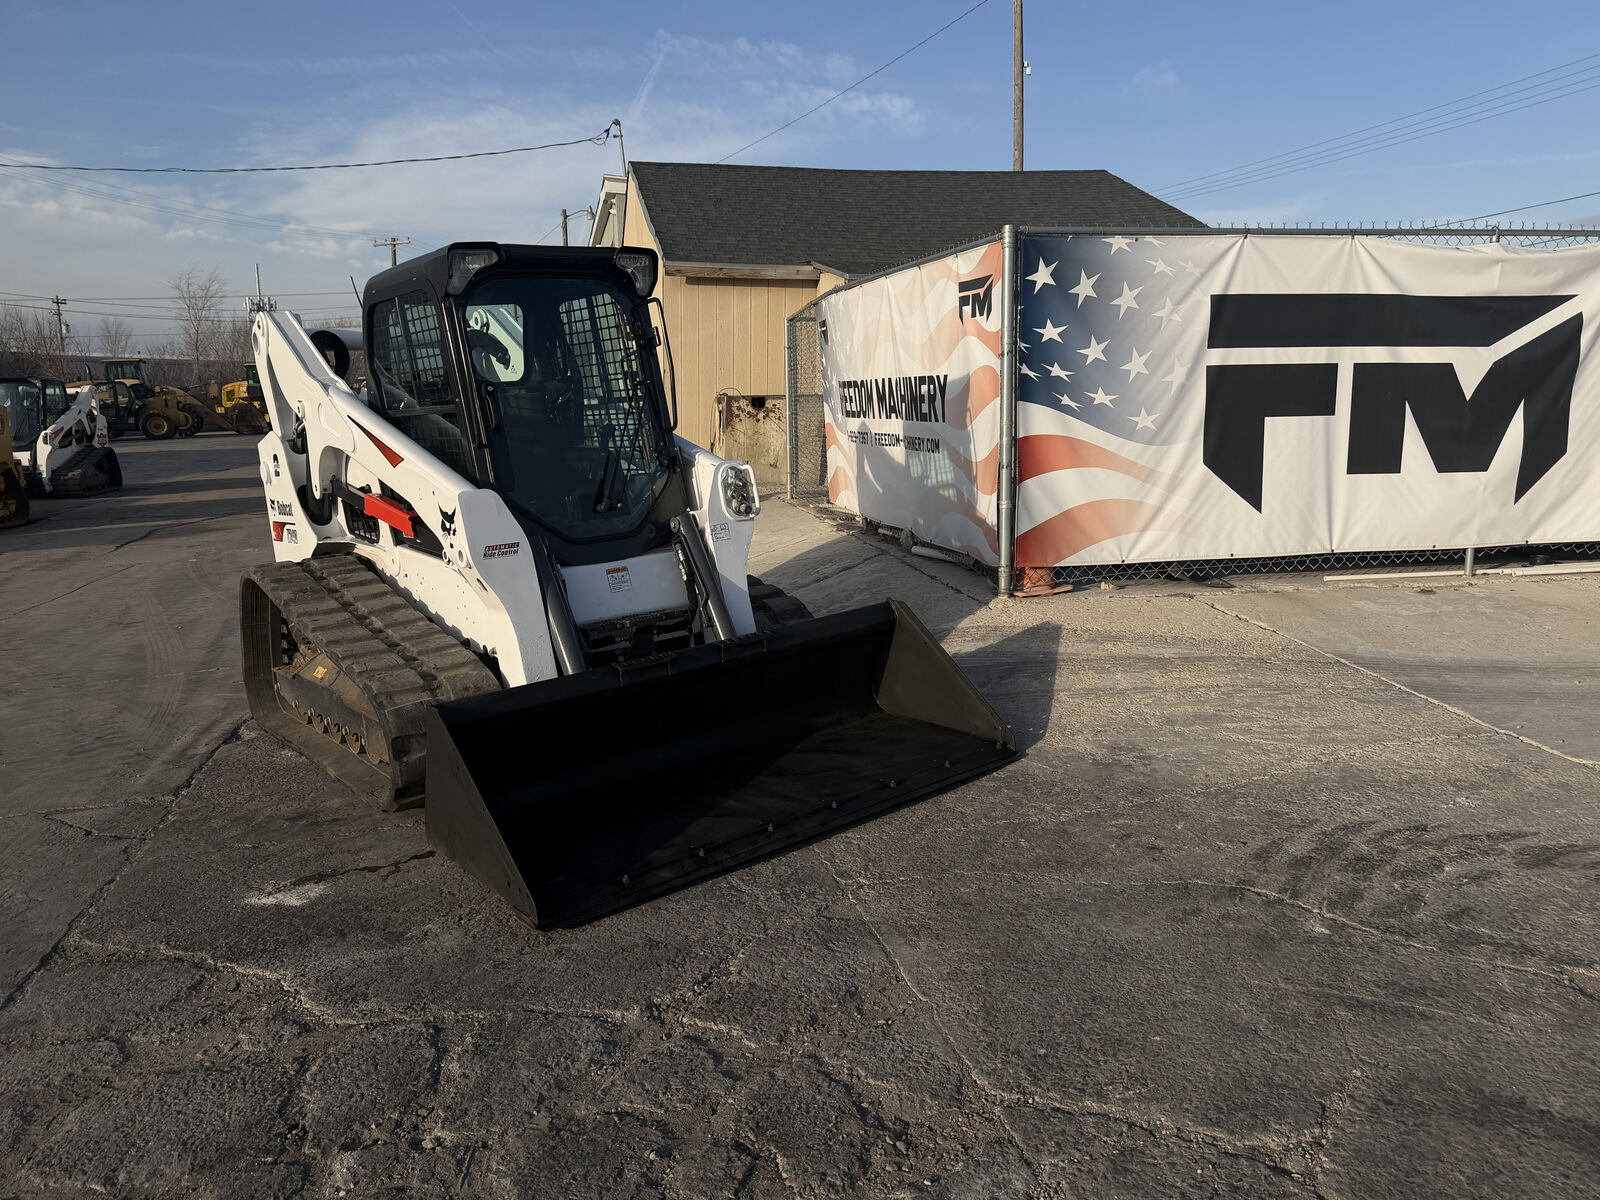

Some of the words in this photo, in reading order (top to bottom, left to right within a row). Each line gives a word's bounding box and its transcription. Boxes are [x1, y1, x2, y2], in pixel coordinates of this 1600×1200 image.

[958, 273, 994, 327] FM
[1202, 294, 1584, 514] FM
[482, 551, 497, 559] Ride
[497, 548, 519, 557] Control
[484, 542, 520, 552] AUTOMATIC
